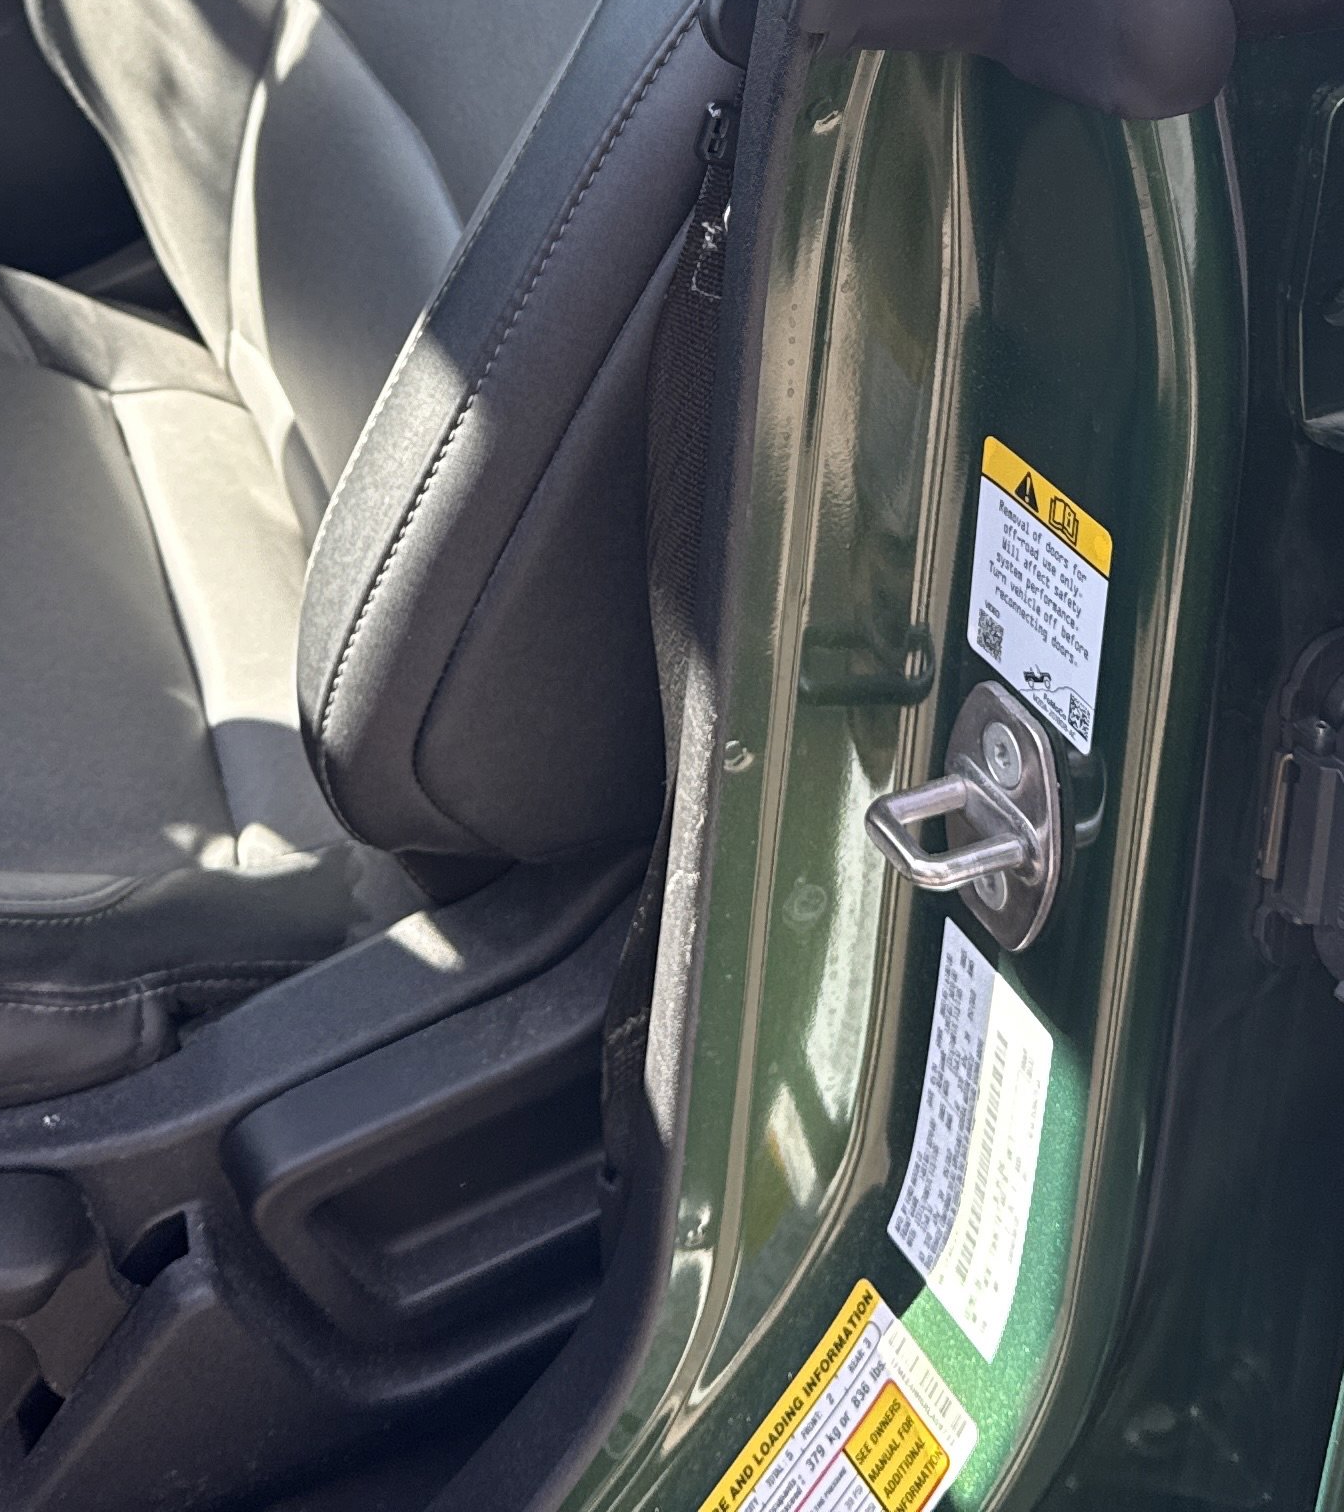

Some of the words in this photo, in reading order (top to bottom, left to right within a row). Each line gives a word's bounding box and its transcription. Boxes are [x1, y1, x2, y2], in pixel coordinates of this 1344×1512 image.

[996, 551, 1022, 584] system
[999, 499, 1030, 535] Removal
[1033, 528, 1042, 545] of
[1046, 540, 1069, 569] doors
[1073, 563, 1087, 584] for
[1004, 521, 1039, 560] off-road
[1043, 557, 1056, 576] use
[990, 560, 1007, 585] Turn
[1010, 579, 1041, 616] vehicle
[1044, 609, 1057, 630] off
[1061, 625, 1089, 660] before
[1002, 536, 1020, 561] Will
[1024, 555, 1050, 589] affect
[1054, 583, 1081, 619] safety
[995, 584, 1048, 642] reconnecting
[729, 1464, 754, 1500] AND
[754, 1397, 804, 1465] LOADING
[805, 1290, 873, 1397] INFORMATION
[805, 1444, 825, 1472] 379
[825, 1424, 841, 1446] kg
[839, 1412, 851, 1428] or
[850, 1381, 870, 1409] 836
[825, 1392, 834, 1404] 2
[855, 1441, 872, 1466] SEE
[872, 1399, 901, 1445] OWNERS
[867, 1437, 900, 1483] MANUAL
[898, 1415, 915, 1440] FOR
[883, 1437, 926, 1499] ADDITIONAL
[895, 1450, 943, 1512] NFORMATION
